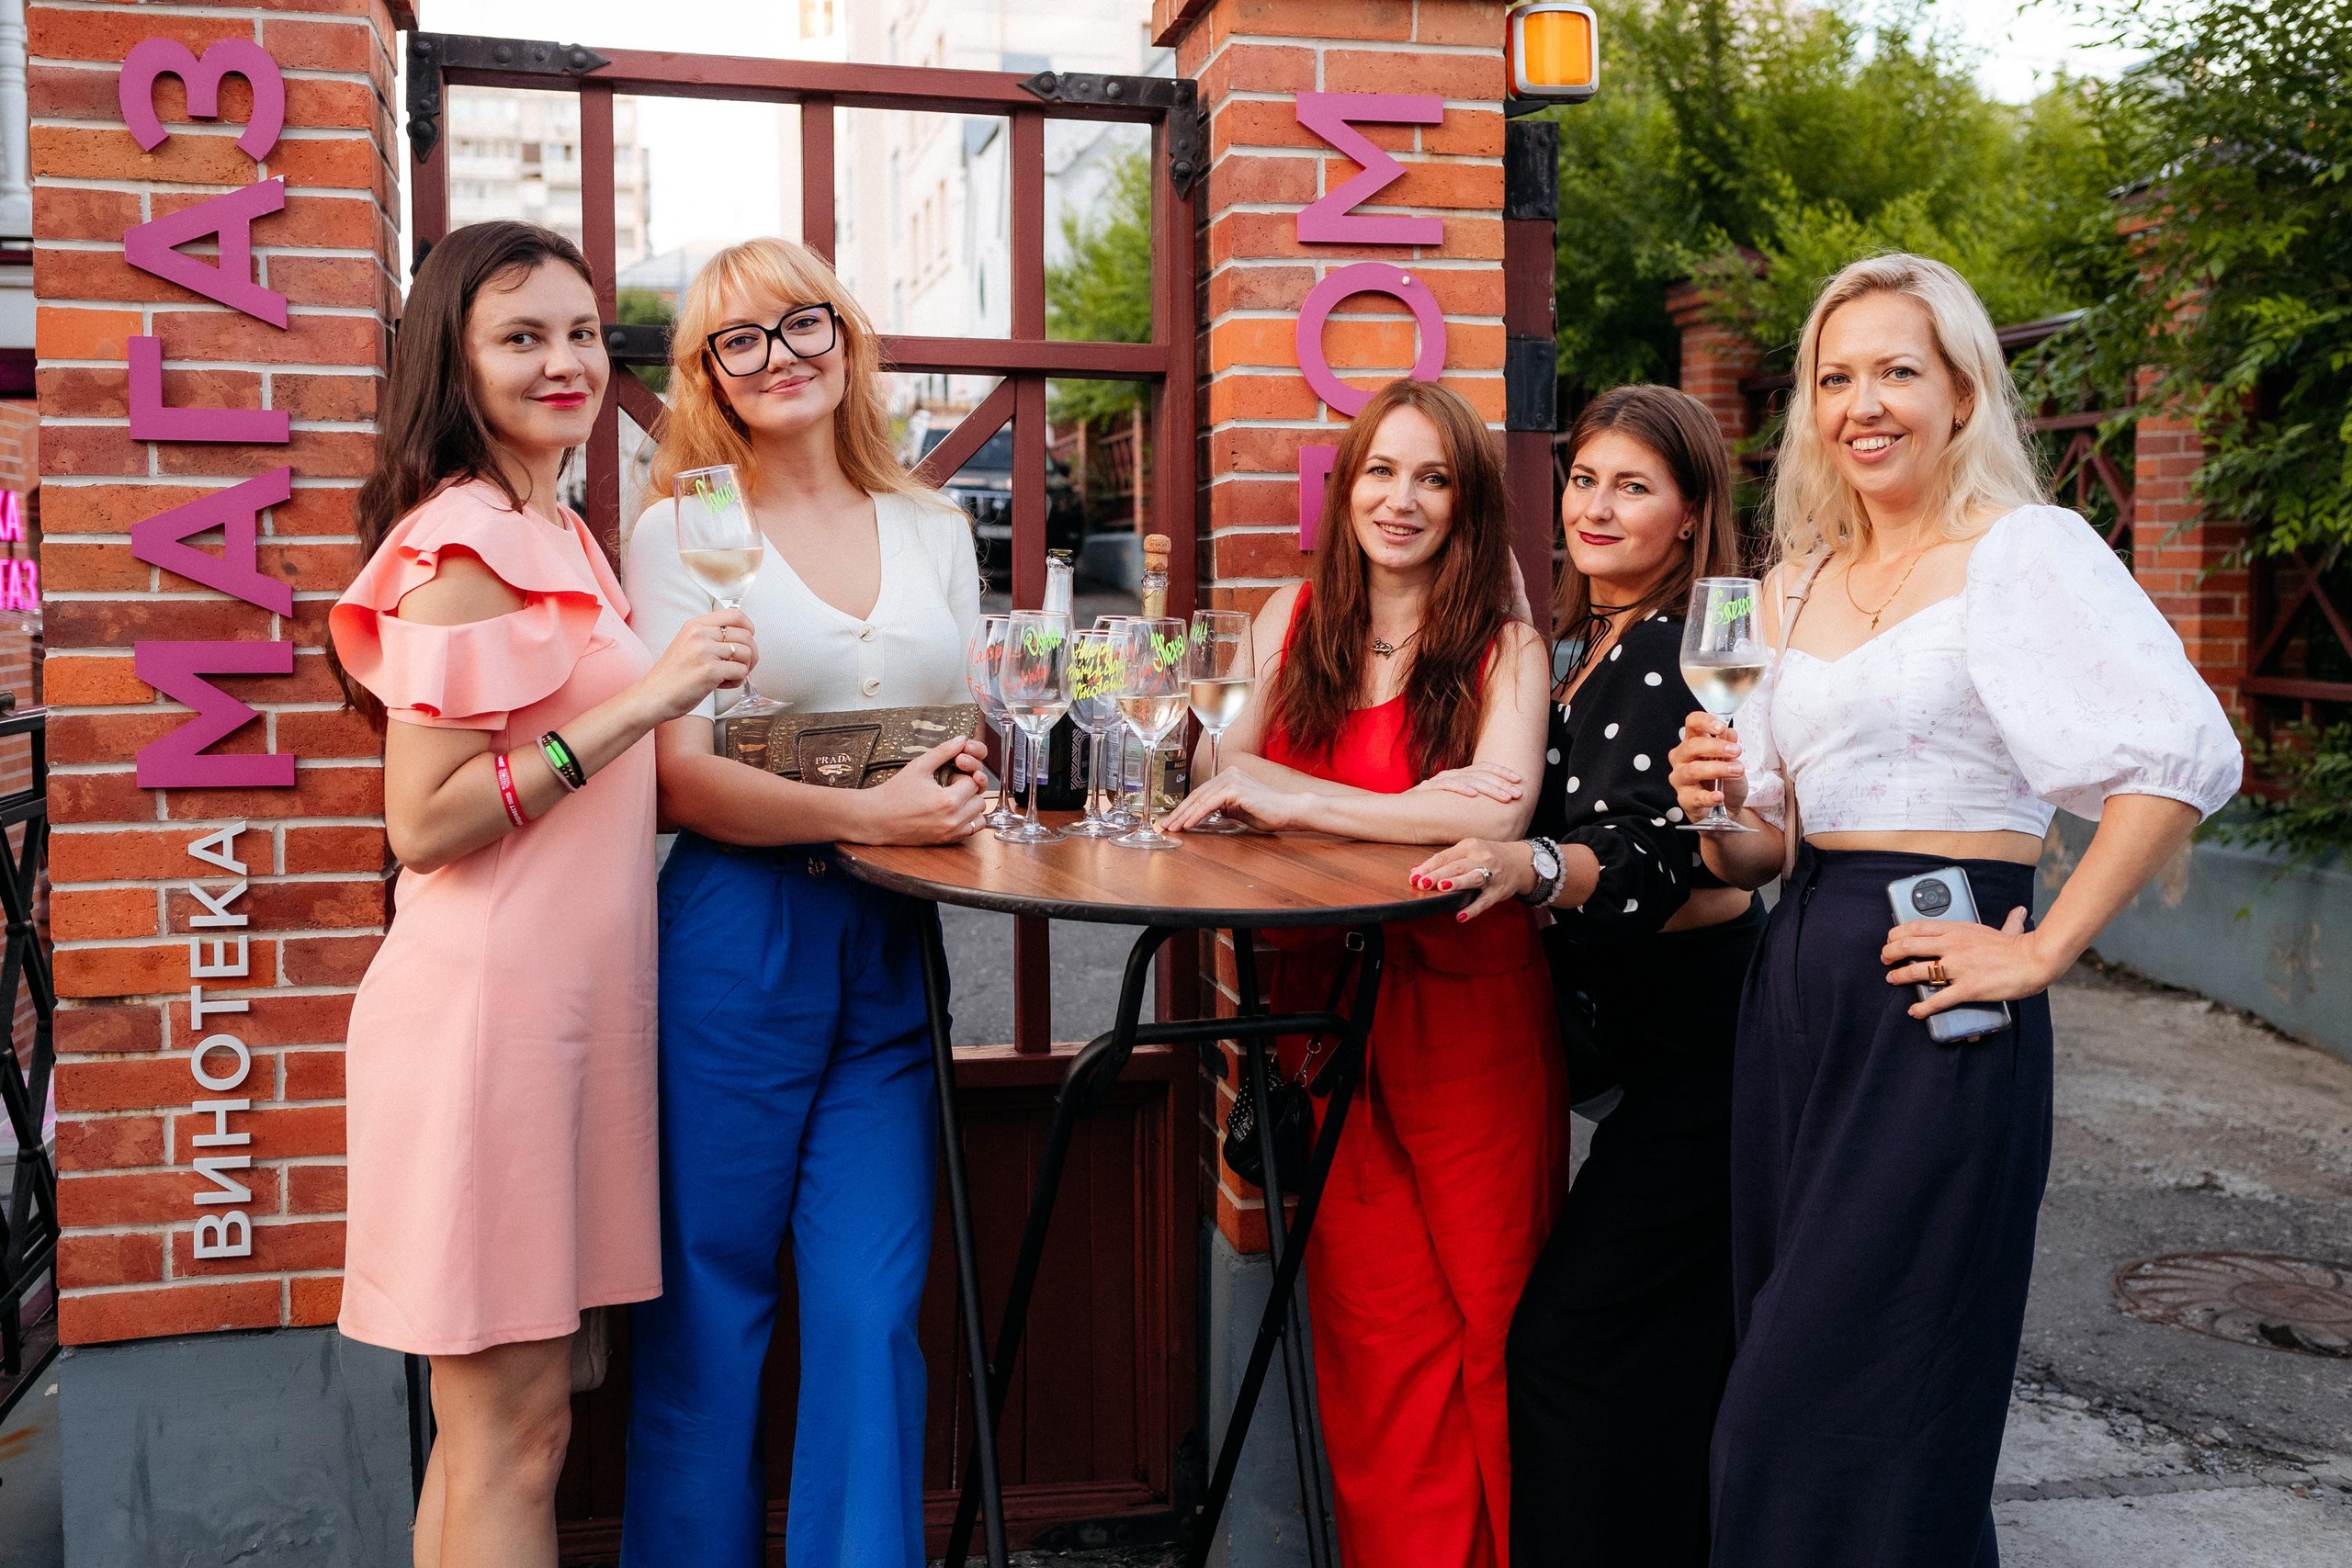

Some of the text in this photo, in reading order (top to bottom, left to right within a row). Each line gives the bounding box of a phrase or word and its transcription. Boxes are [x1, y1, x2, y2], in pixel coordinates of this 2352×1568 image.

[119, 38, 296, 788] МАГАЗ
[815, 754, 852, 765] PRADA
[187, 820, 252, 1259] ВИНОТЕКА
